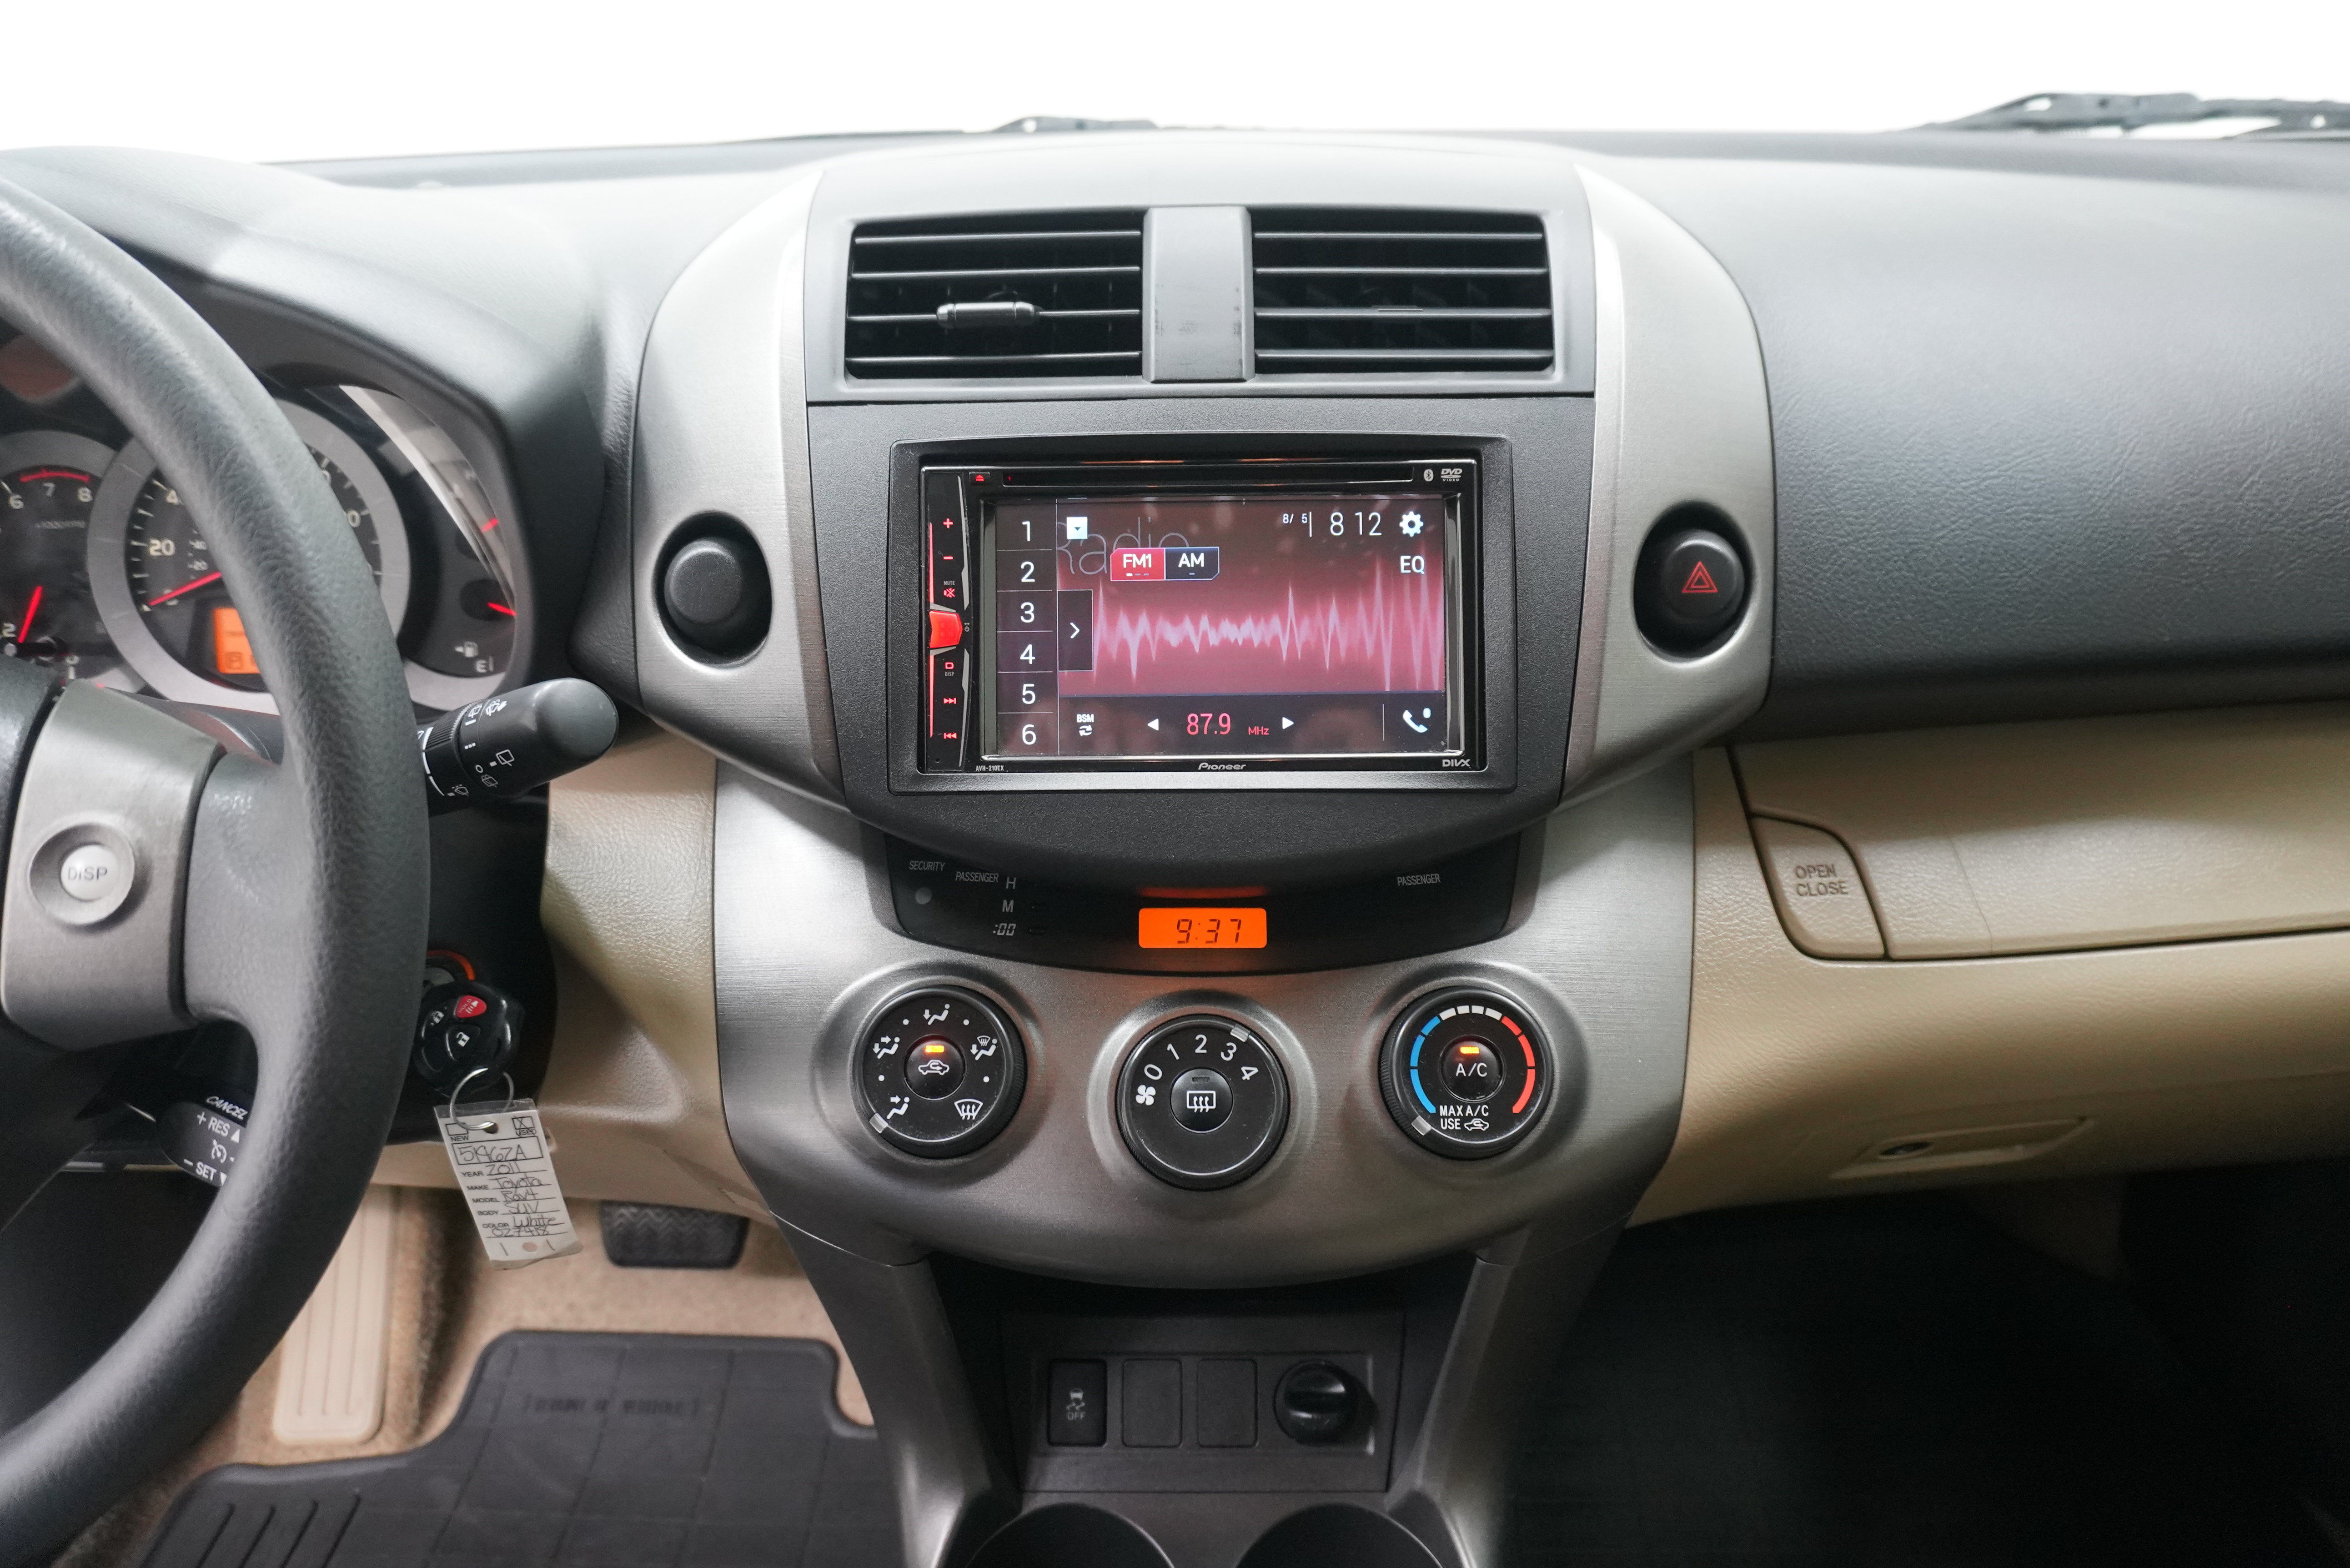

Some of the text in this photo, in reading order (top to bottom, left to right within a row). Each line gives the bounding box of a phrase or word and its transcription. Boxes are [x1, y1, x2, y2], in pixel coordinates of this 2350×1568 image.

[42, 482, 55, 497] 7
[78, 487, 92, 502] 8
[9, 495, 24, 509] 6
[1022, 521, 1031, 541] 1
[149, 539, 176, 556] 20
[1123, 553, 1152, 568] FM1
[1178, 553, 1205, 568] AM
[1401, 556, 1425, 574] EQ
[1021, 562, 1035, 582] 2
[1020, 603, 1034, 623] 3
[1020, 645, 1035, 664] 4
[476, 659, 488, 673] E
[1022, 684, 1036, 704] 5
[1076, 714, 1094, 723] BSM
[1187, 713, 1270, 735] 87.9 MHz
[1022, 724, 1036, 745] 6
[1198, 762, 1246, 770] Pioneer
[909, 860, 945, 871] SECURITY
[1795, 864, 1838, 879] OPEN
[955, 871, 999, 883] PASSENGER
[1006, 877, 1016, 889] H
[1397, 873, 1441, 886] PASSENGER
[1797, 881, 1849, 896] CLOSE
[1002, 900, 1014, 912] M
[1176, 919, 1241, 944] 9:37
[1195, 1034, 1207, 1053] 2
[1167, 1043, 1180, 1060] 1
[1220, 1042, 1237, 1061] 3
[1144, 1064, 1162, 1080] 0
[1241, 1066, 1259, 1081] 4
[1456, 1062, 1487, 1077] A/C
[206, 1096, 248, 1120] CANCEL
[1439, 1105, 1489, 1116] MAX A/C
[208, 1116, 231, 1137] RES
[1441, 1118, 1461, 1130] USE
[196, 1161, 217, 1181] SET
